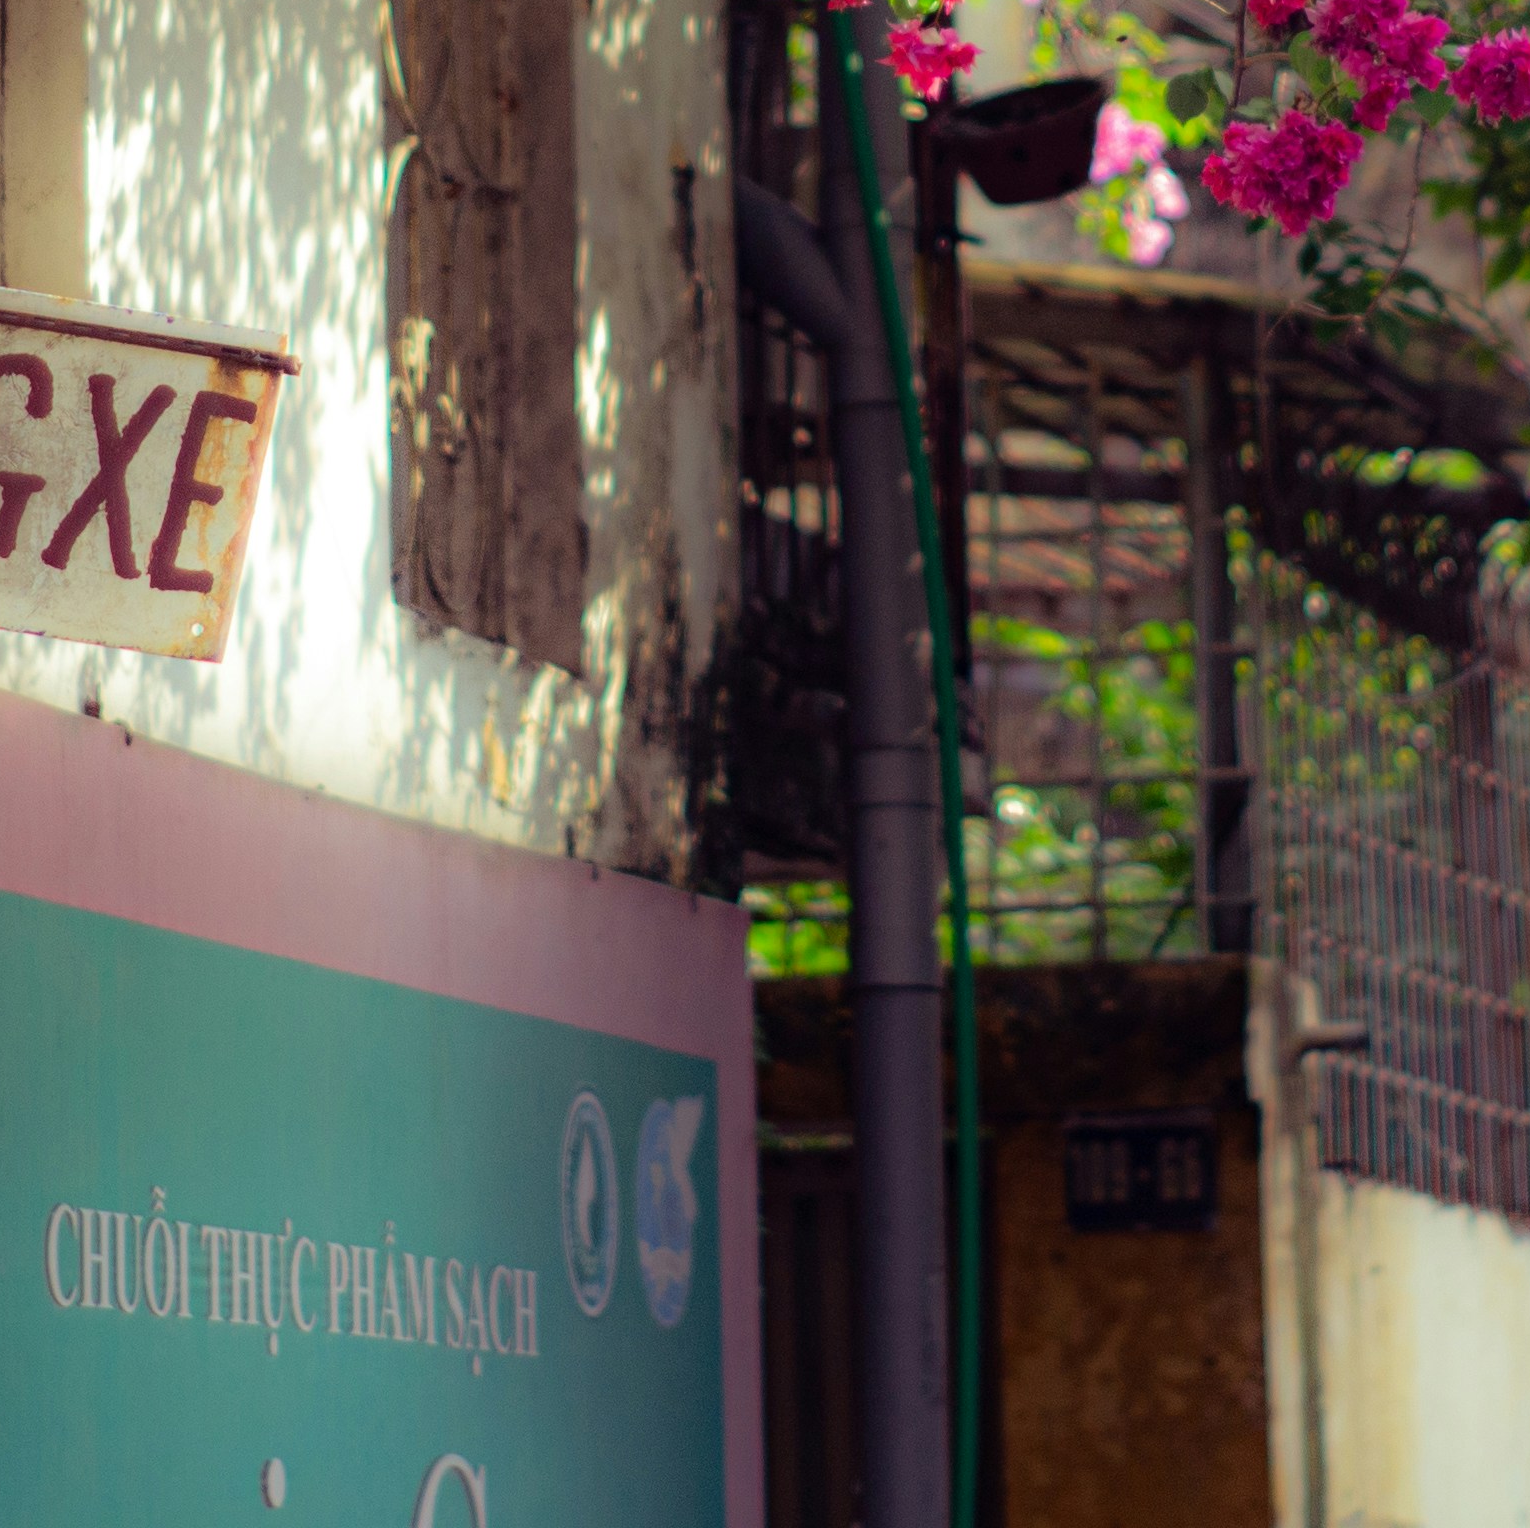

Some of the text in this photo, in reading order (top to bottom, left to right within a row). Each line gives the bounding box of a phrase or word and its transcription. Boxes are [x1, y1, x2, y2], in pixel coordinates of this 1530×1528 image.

[46, 1184, 540, 1376] CHUỖI THỰC PHẨM SẠCH
